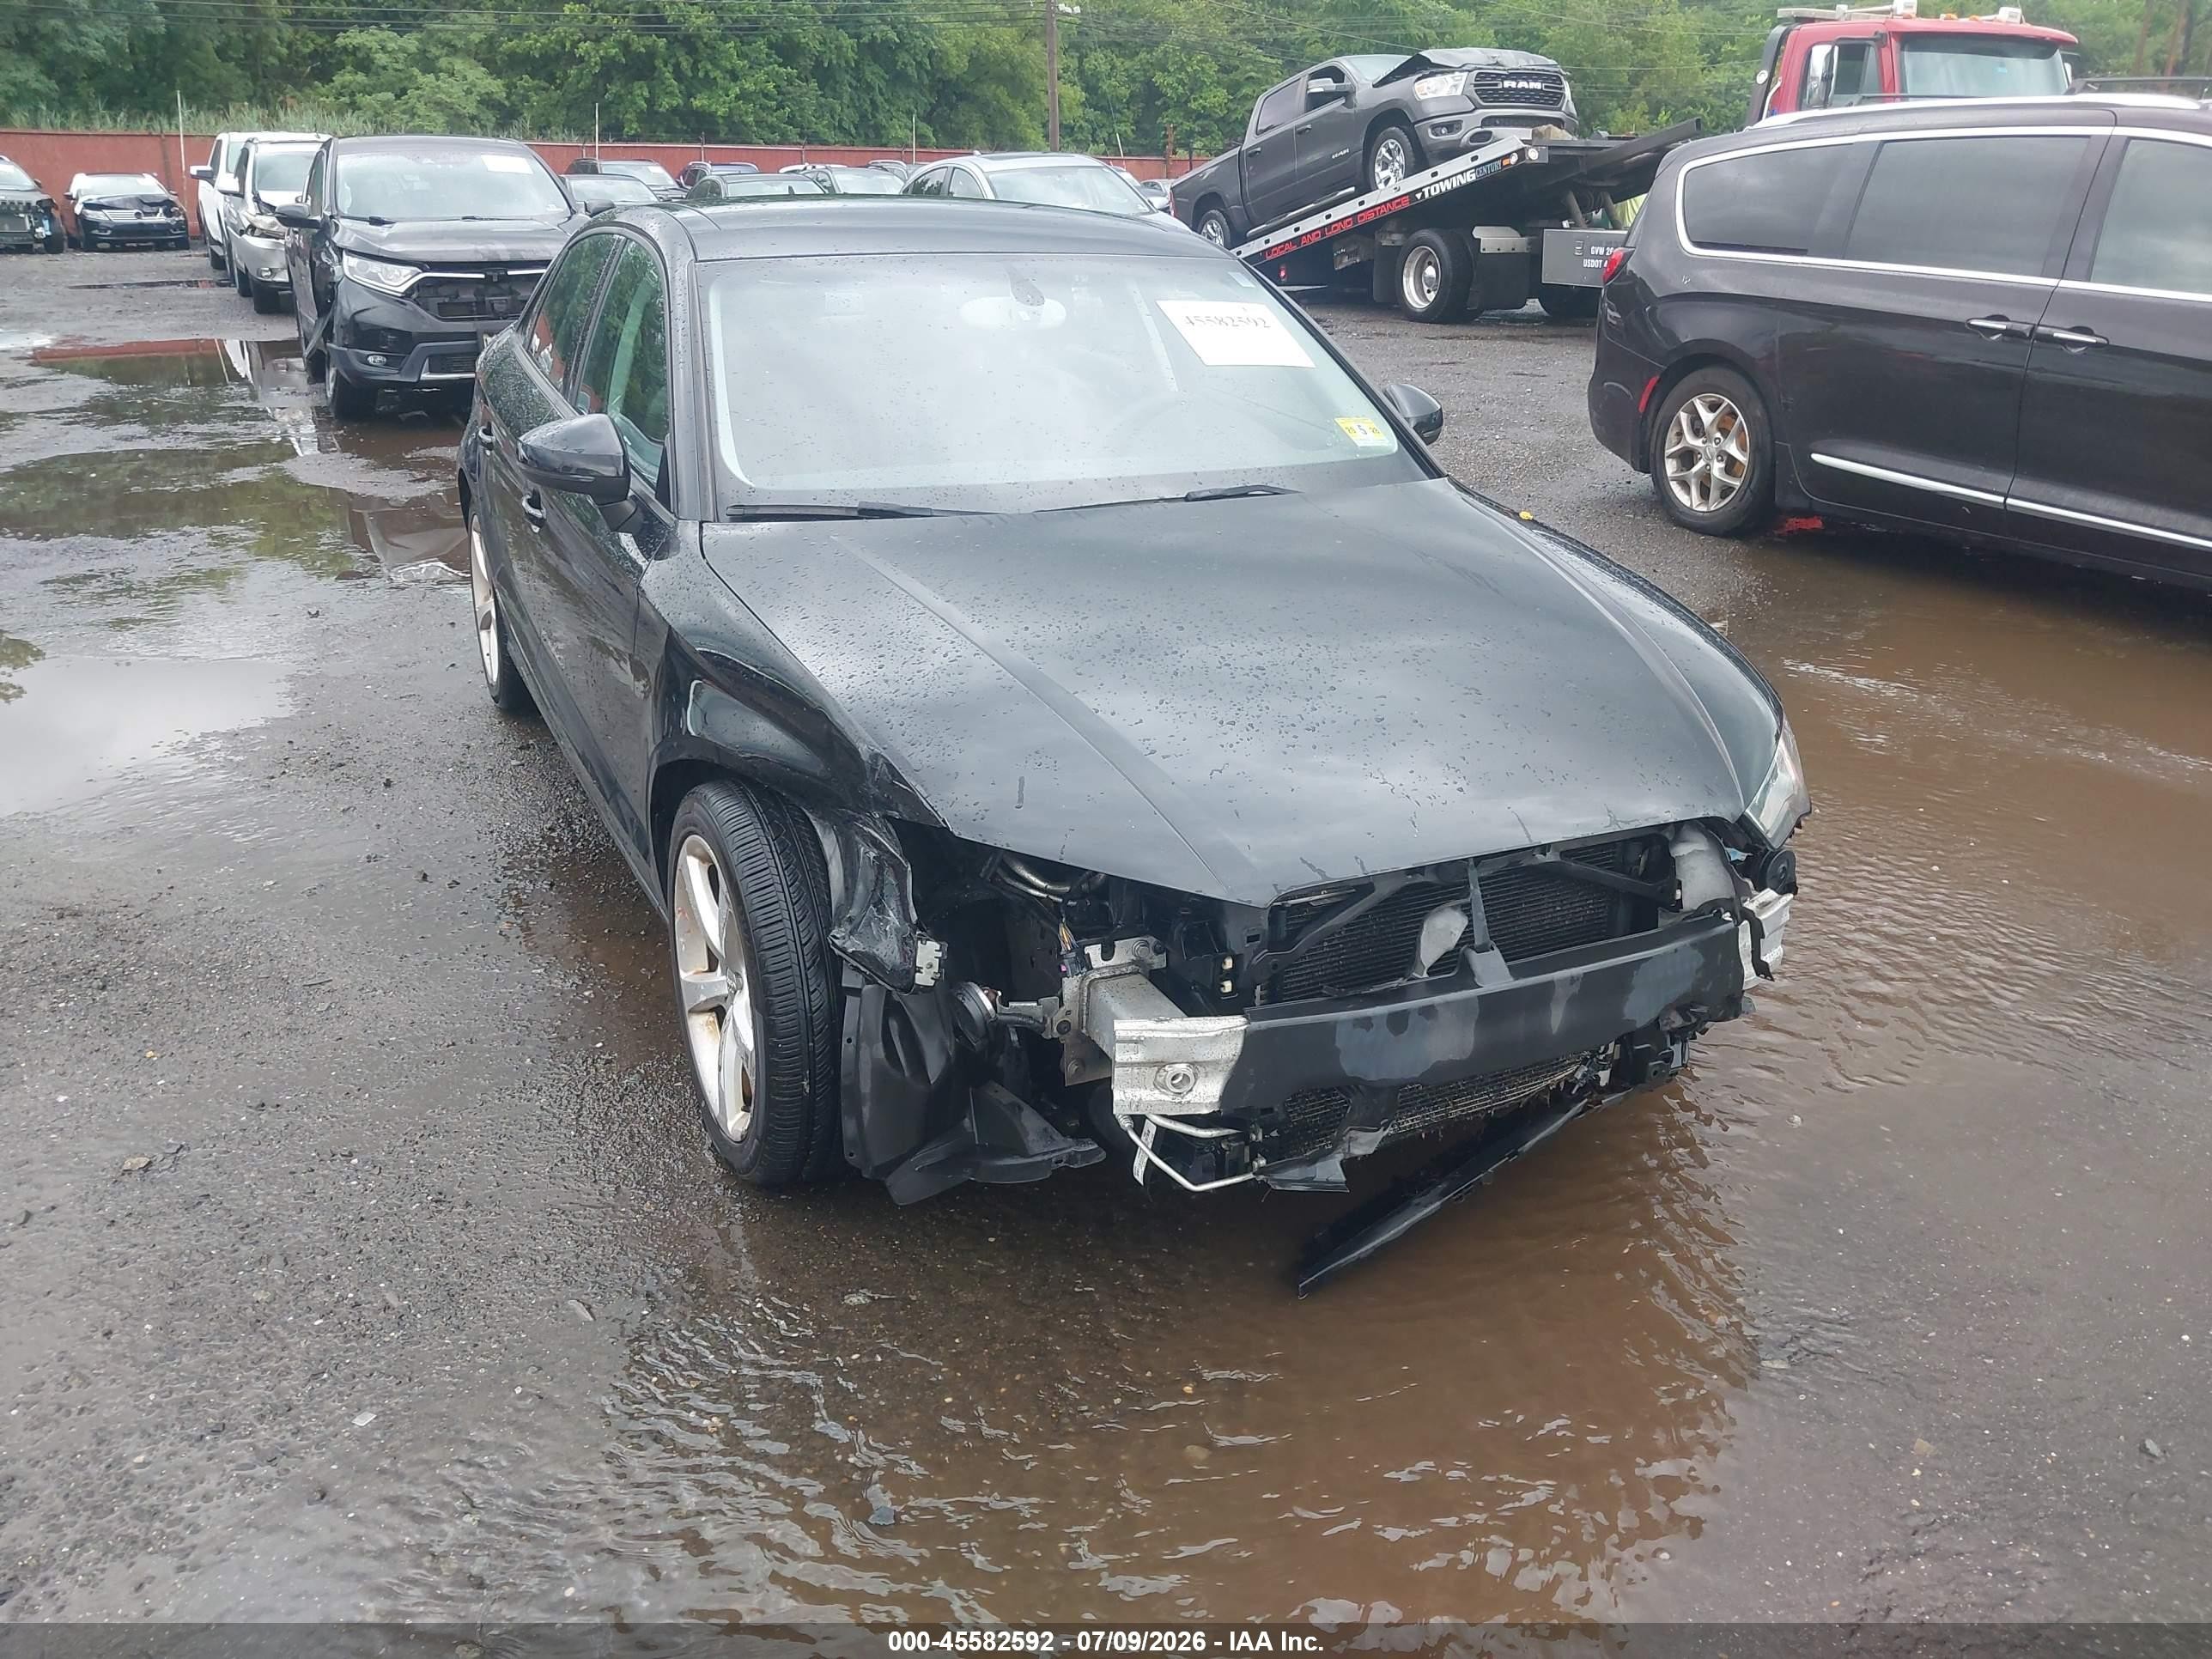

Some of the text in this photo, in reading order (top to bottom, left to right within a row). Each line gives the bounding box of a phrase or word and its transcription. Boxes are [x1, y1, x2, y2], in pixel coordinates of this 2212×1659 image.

[1503, 81, 1542, 89] RAM
[1475, 159, 1503, 178] CENTURY
[1422, 168, 1477, 199] TOWING
[1265, 195, 1410, 260] LOCAL AND LONG DISTANCE
[1590, 246, 1605, 256] GVW
[1583, 258, 1603, 268] USDOT
